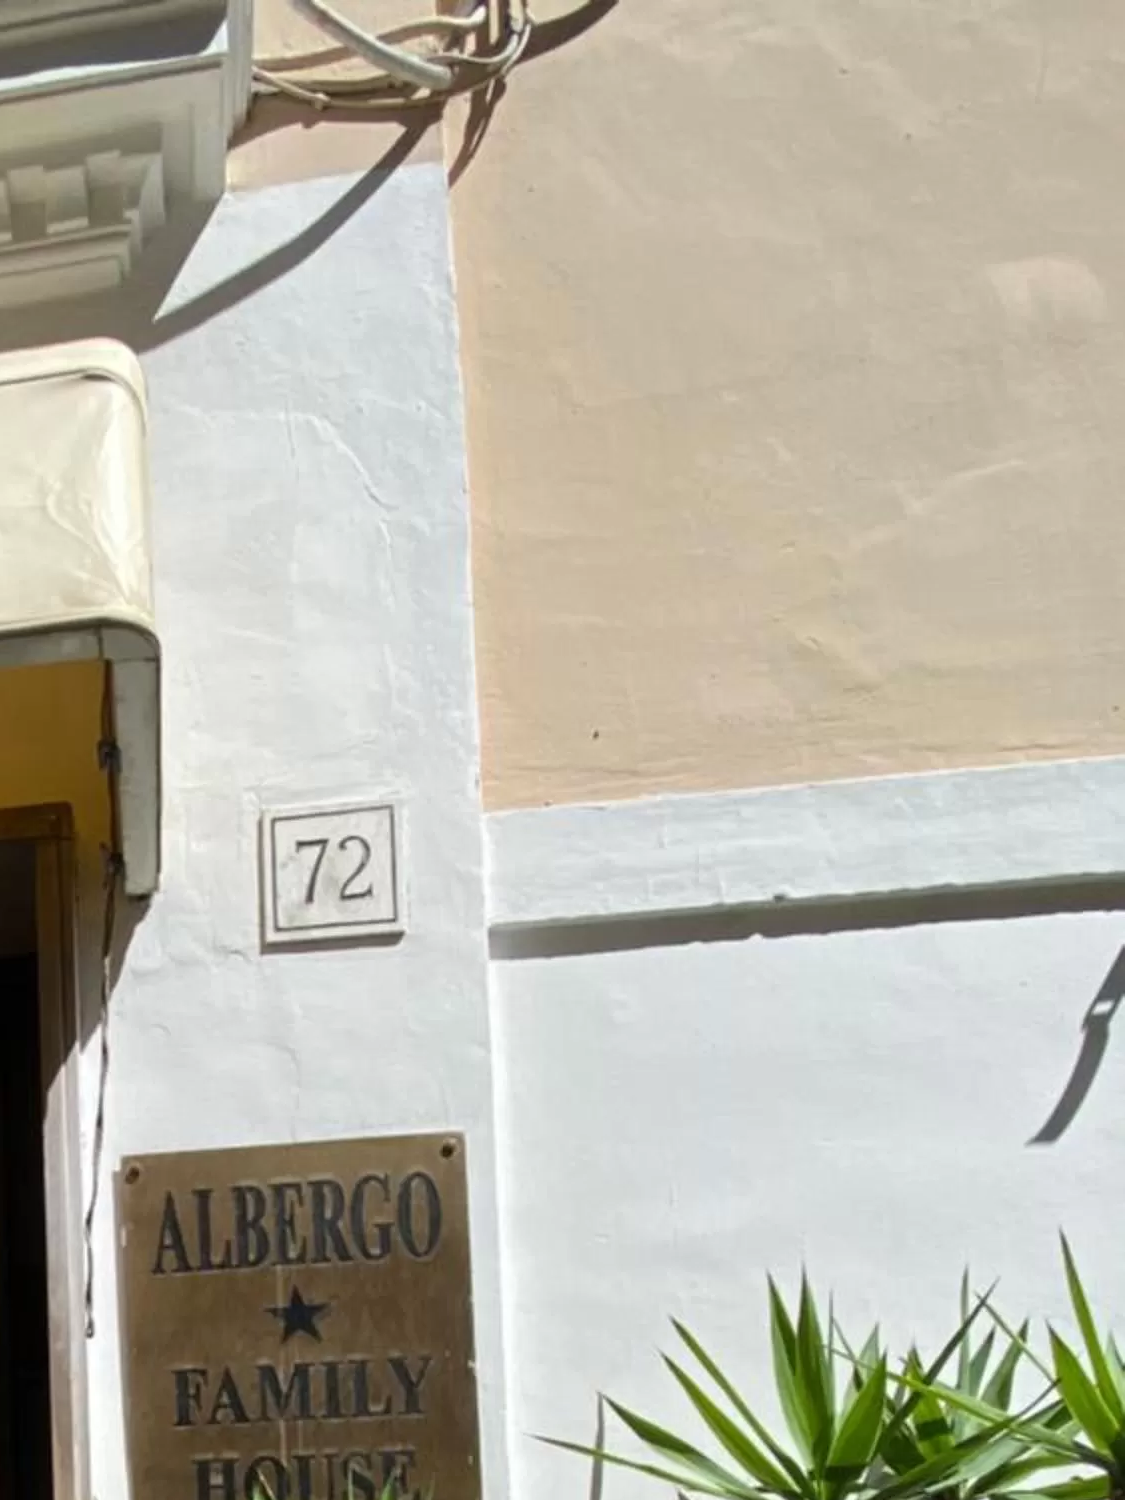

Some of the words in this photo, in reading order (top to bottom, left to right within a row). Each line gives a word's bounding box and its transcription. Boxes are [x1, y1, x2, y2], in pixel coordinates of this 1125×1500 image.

[294, 834, 374, 905] 72
[150, 1170, 443, 1276] ALBERGO
[170, 1353, 434, 1428] FAMILY
